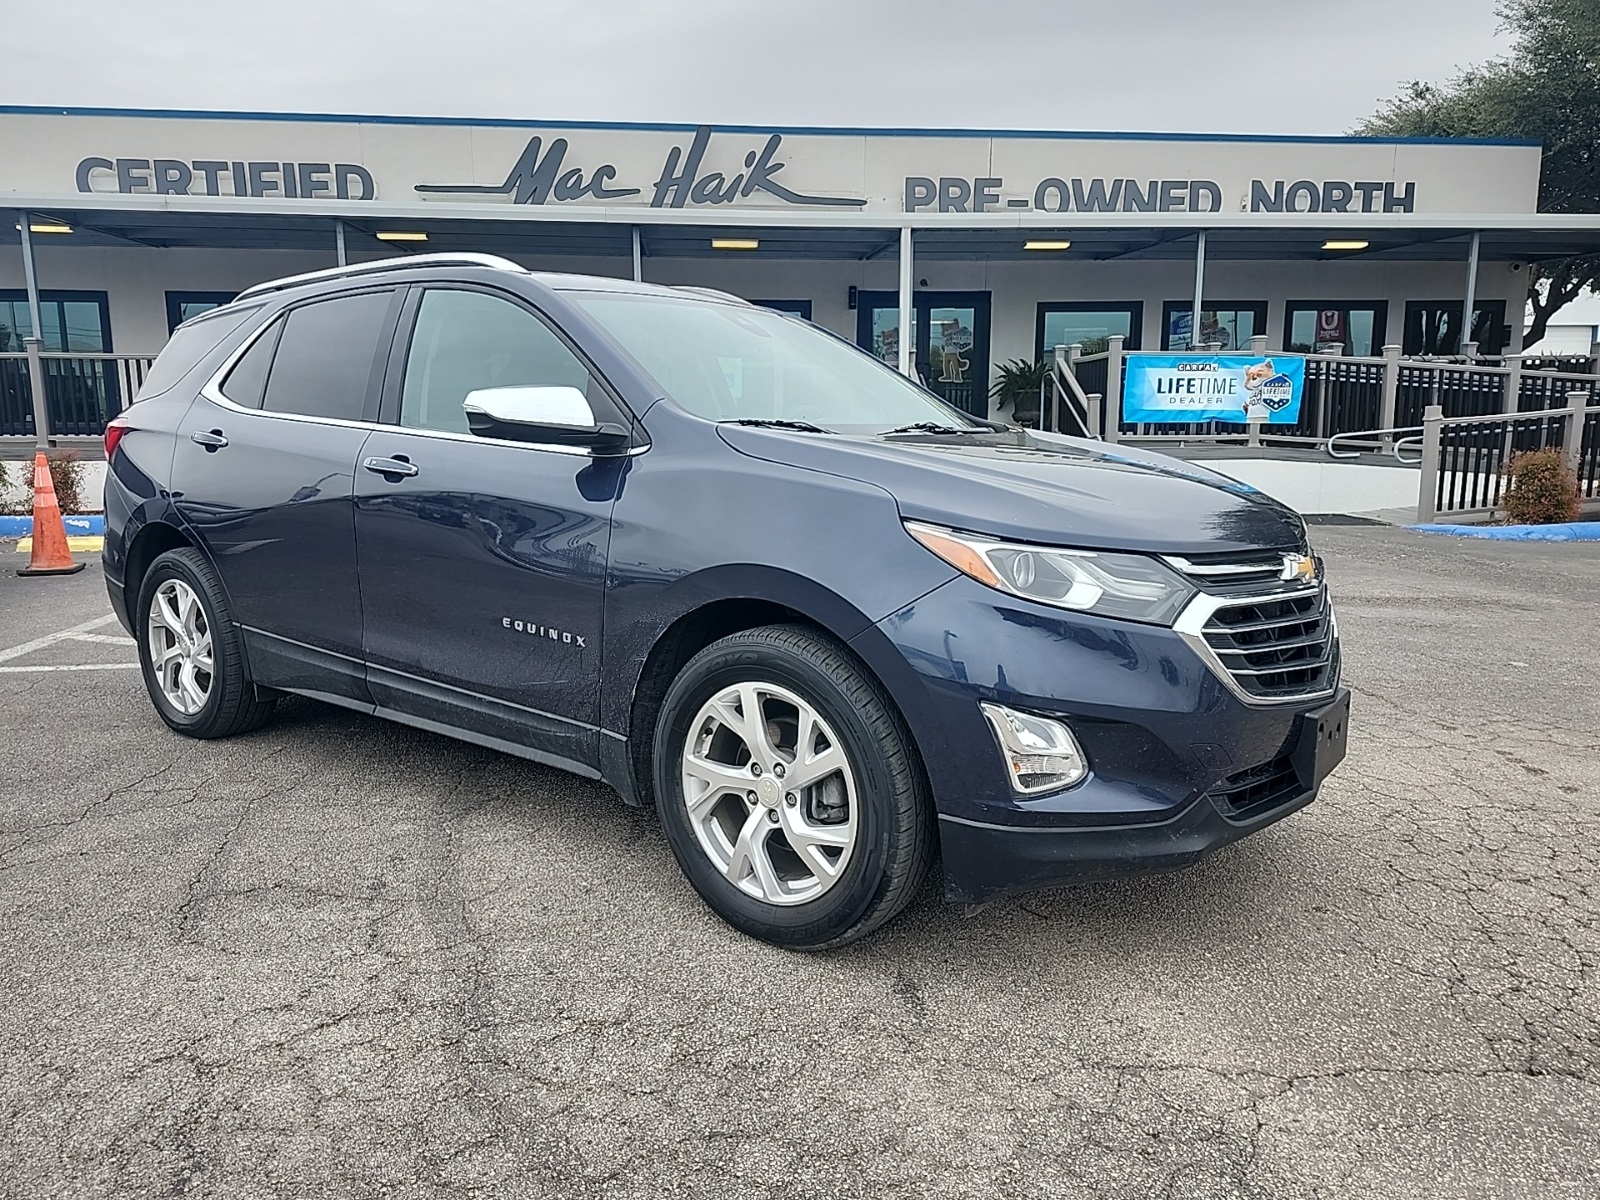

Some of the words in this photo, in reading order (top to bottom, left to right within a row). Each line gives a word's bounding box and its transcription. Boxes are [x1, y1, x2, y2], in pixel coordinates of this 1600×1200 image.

[75, 156, 375, 201] CERTIFIED
[414, 136, 641, 205] Mac
[649, 125, 868, 209] Haik
[904, 176, 1222, 214] PRE-OWNED
[1250, 179, 1415, 214] NORTH
[1177, 363, 1219, 372] CARFAX
[1156, 377, 1238, 395] LIFETIME
[502, 617, 586, 648] EQUINOX
